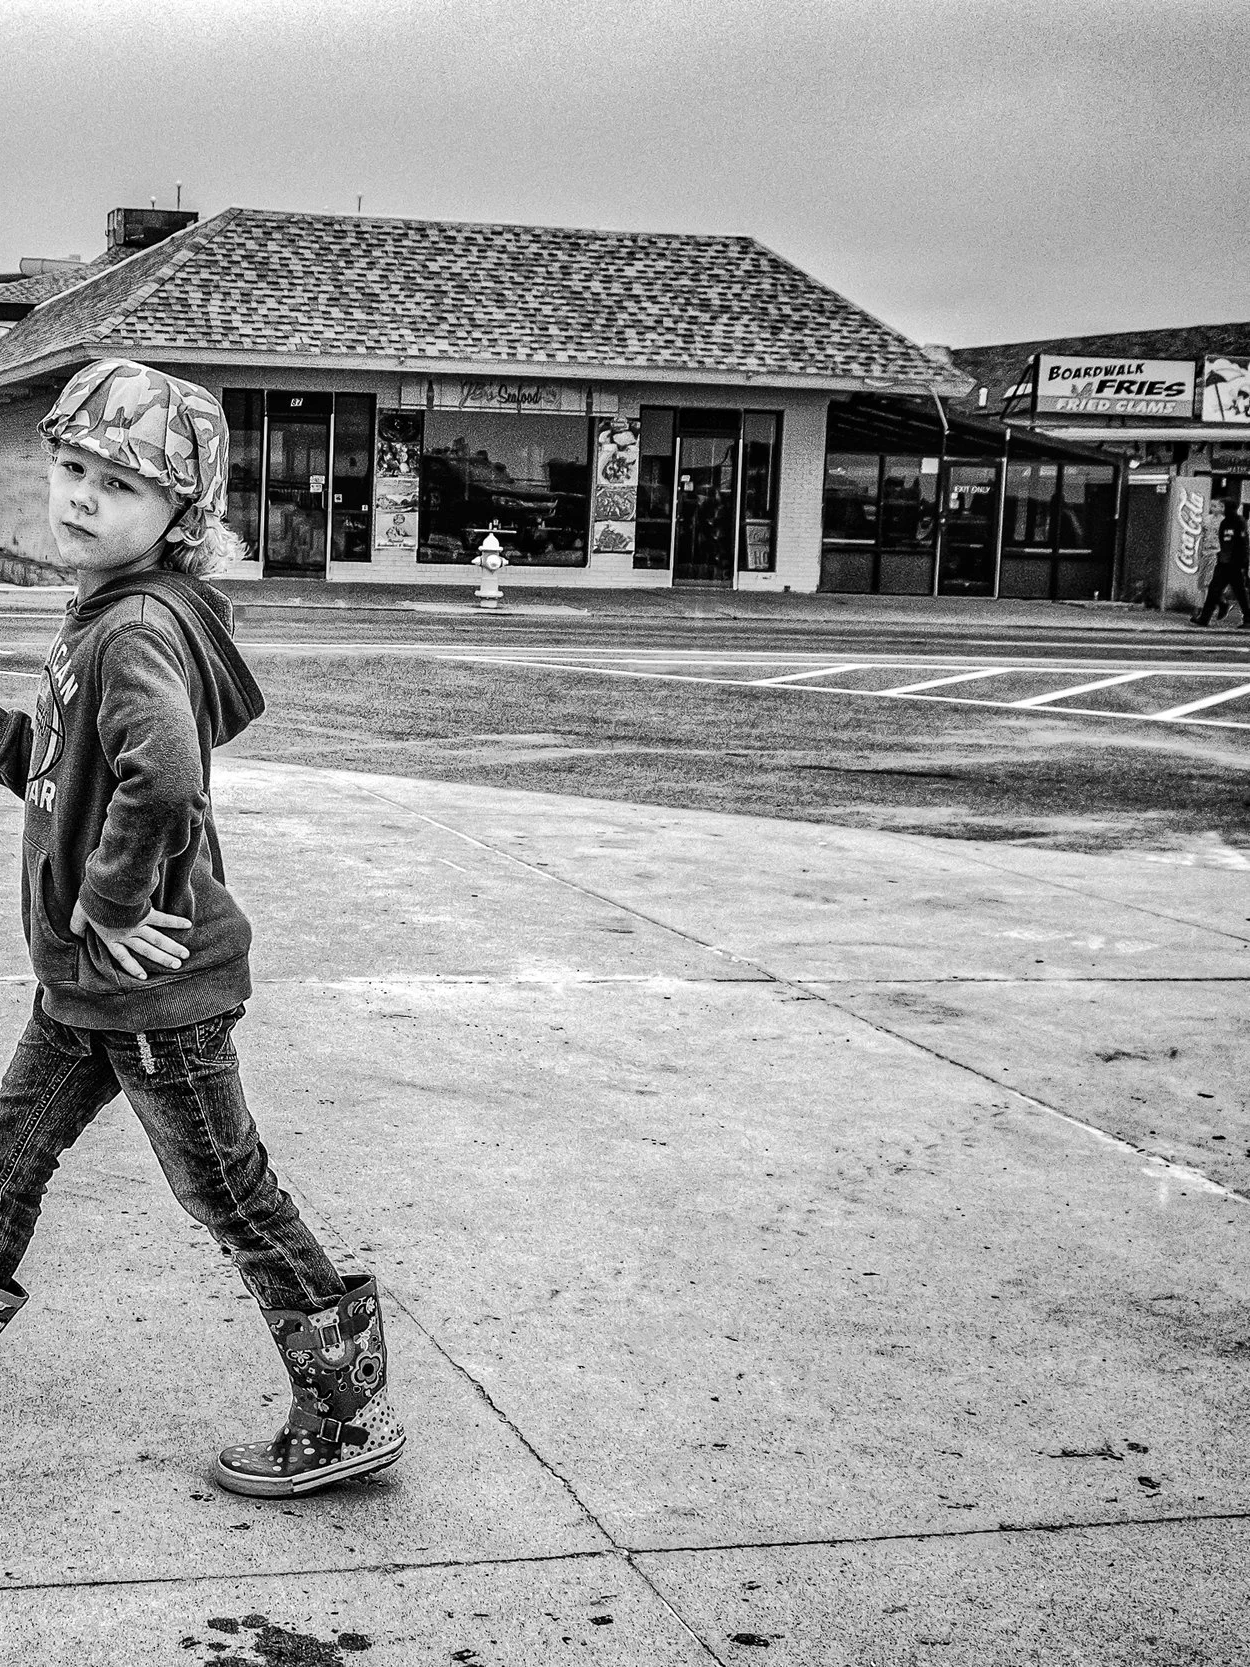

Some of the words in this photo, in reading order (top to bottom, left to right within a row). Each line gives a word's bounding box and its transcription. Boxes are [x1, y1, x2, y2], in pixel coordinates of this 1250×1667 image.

[1048, 363, 1145, 381] BOARDWALK
[1095, 379, 1186, 397] FRIES
[497, 384, 542, 411] Seafood
[1056, 398, 1110, 412] FRIED
[1115, 400, 1176, 414] CLAMS
[954, 485, 969, 493] EXIT
[971, 486, 990, 494] ONLY
